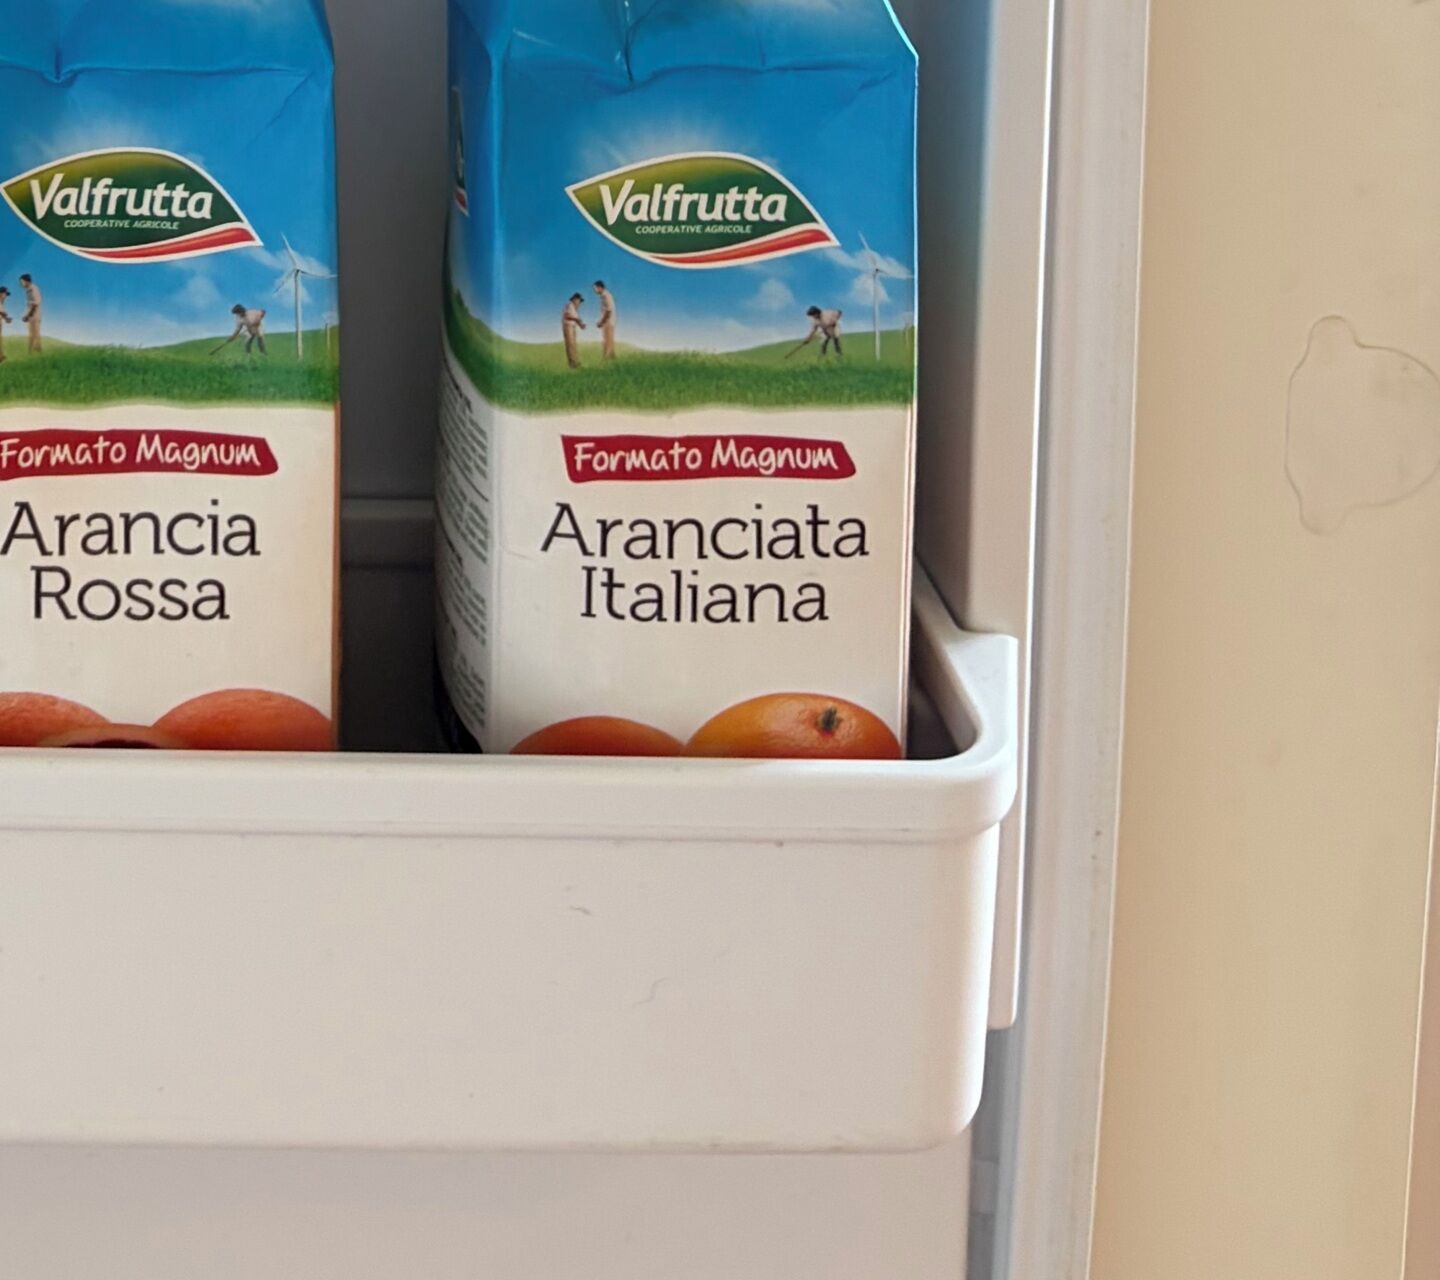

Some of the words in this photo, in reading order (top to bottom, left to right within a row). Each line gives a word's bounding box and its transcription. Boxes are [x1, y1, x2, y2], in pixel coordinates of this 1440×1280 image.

[30, 173, 214, 220] Valfrutta
[599, 179, 788, 226] Valfrutta
[64, 219, 130, 229] COOPERATIVE
[133, 220, 179, 230] AGRICOLE
[635, 224, 701, 234] COOPERATIVE
[704, 224, 753, 234] AGRICOLE
[0, 437, 127, 468] Formato
[135, 434, 261, 470] Magnum
[574, 442, 702, 473] Formato
[711, 439, 839, 475] Magnum
[0, 499, 261, 556] Arancia
[540, 502, 870, 560] Aranciata
[31, 565, 230, 621] Rossa
[580, 566, 829, 622] Italiana
